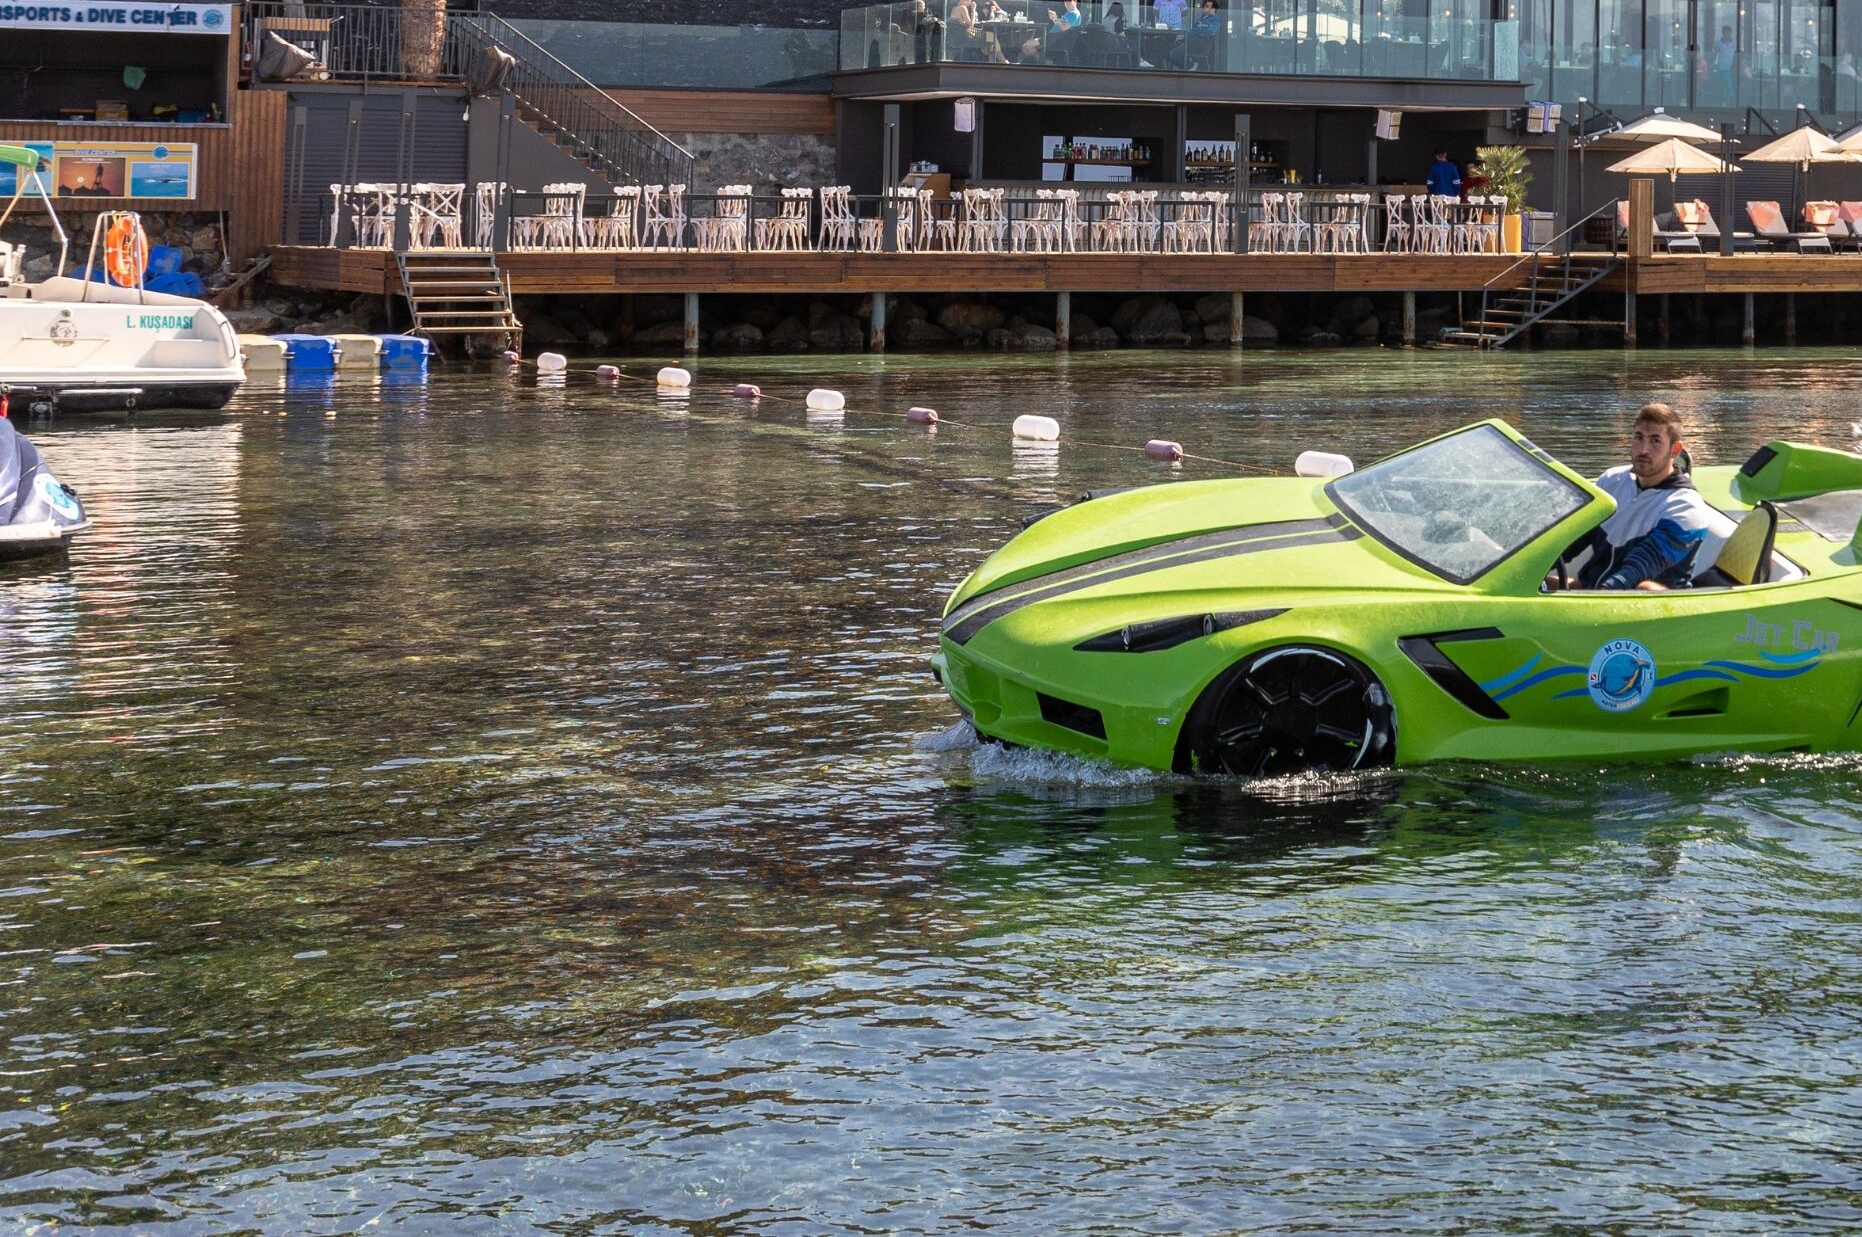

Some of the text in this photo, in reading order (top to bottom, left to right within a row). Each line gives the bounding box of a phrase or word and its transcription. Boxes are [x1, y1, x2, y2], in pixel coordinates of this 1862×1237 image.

[0, 5, 197, 26] SPORTS & DIVE CENTER
[140, 315, 193, 333] KUŞADASI
[1604, 641, 1640, 655] NOVA
